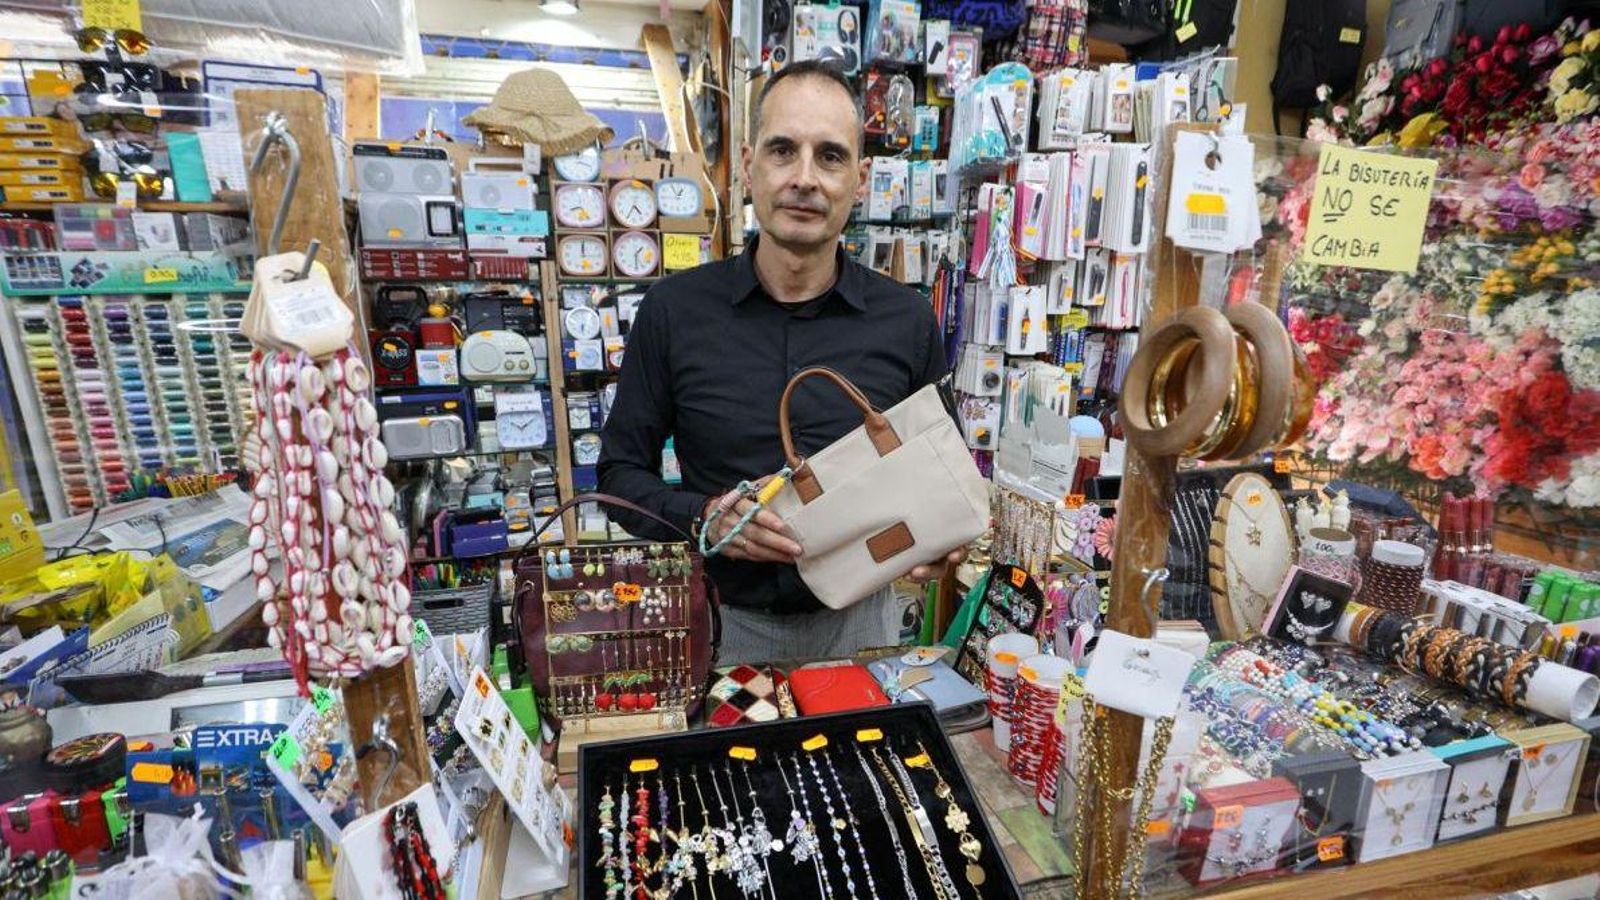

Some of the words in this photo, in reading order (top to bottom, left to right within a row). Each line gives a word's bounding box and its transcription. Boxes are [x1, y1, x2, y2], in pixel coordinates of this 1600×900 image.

[1322, 152, 1340, 176] LA
[1322, 186, 1354, 212] NO
[1370, 195, 1400, 216] SE
